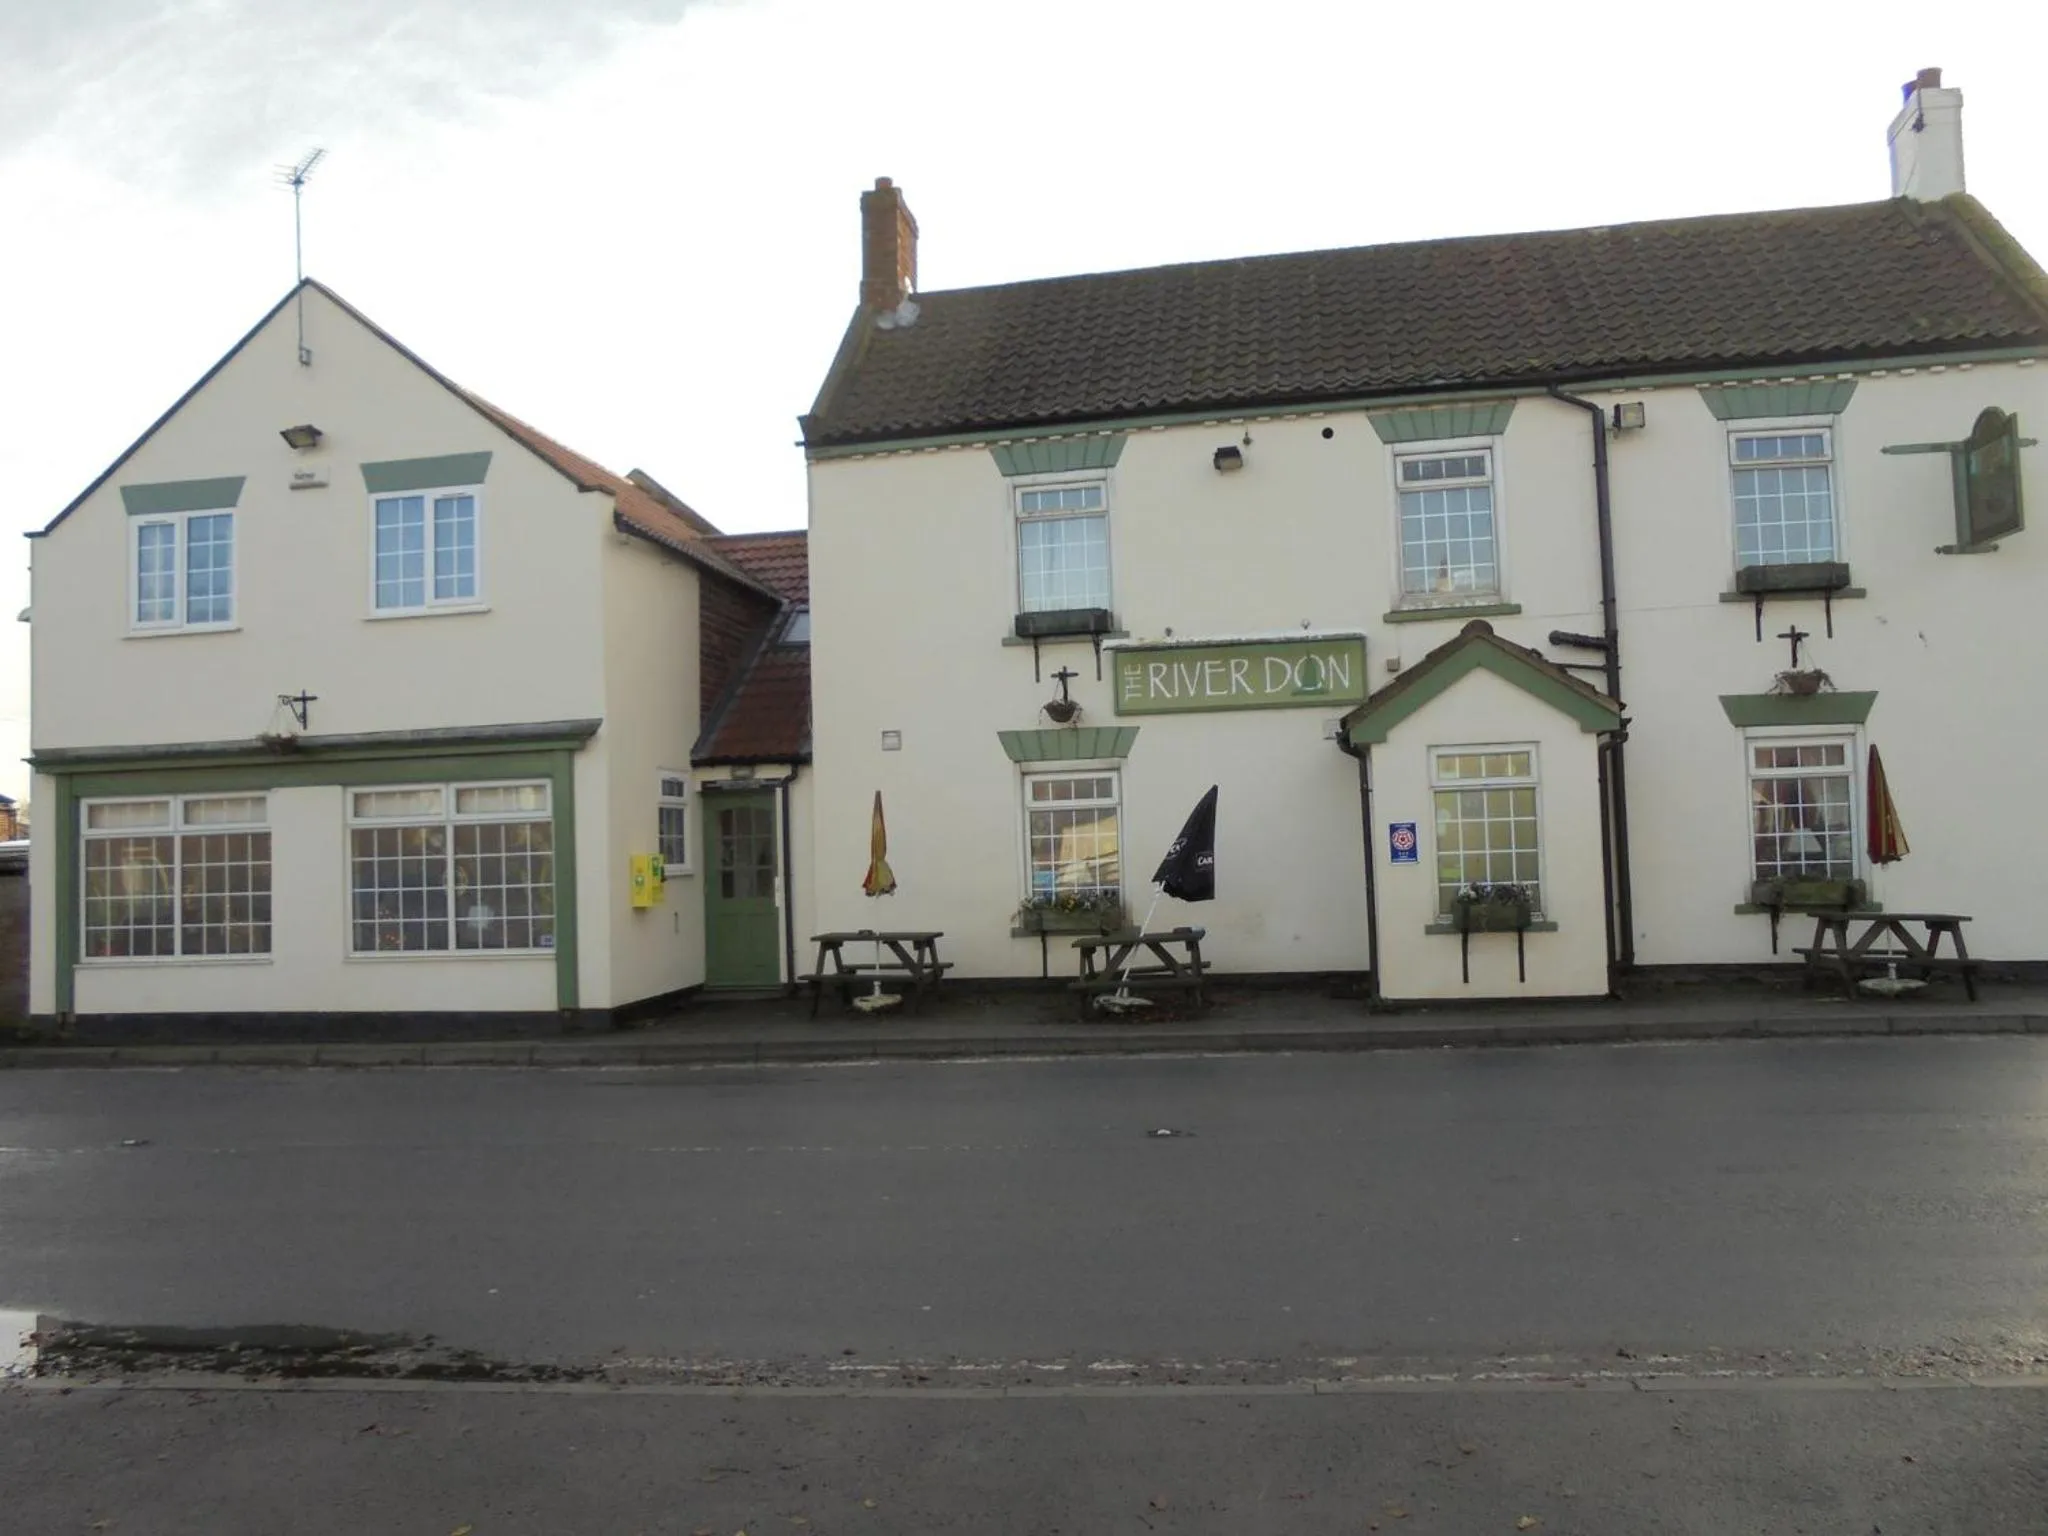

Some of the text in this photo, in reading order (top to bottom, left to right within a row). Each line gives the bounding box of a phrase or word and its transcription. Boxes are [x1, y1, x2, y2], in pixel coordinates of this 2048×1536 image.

[1124, 653, 1349, 701] THE RIVER DON
